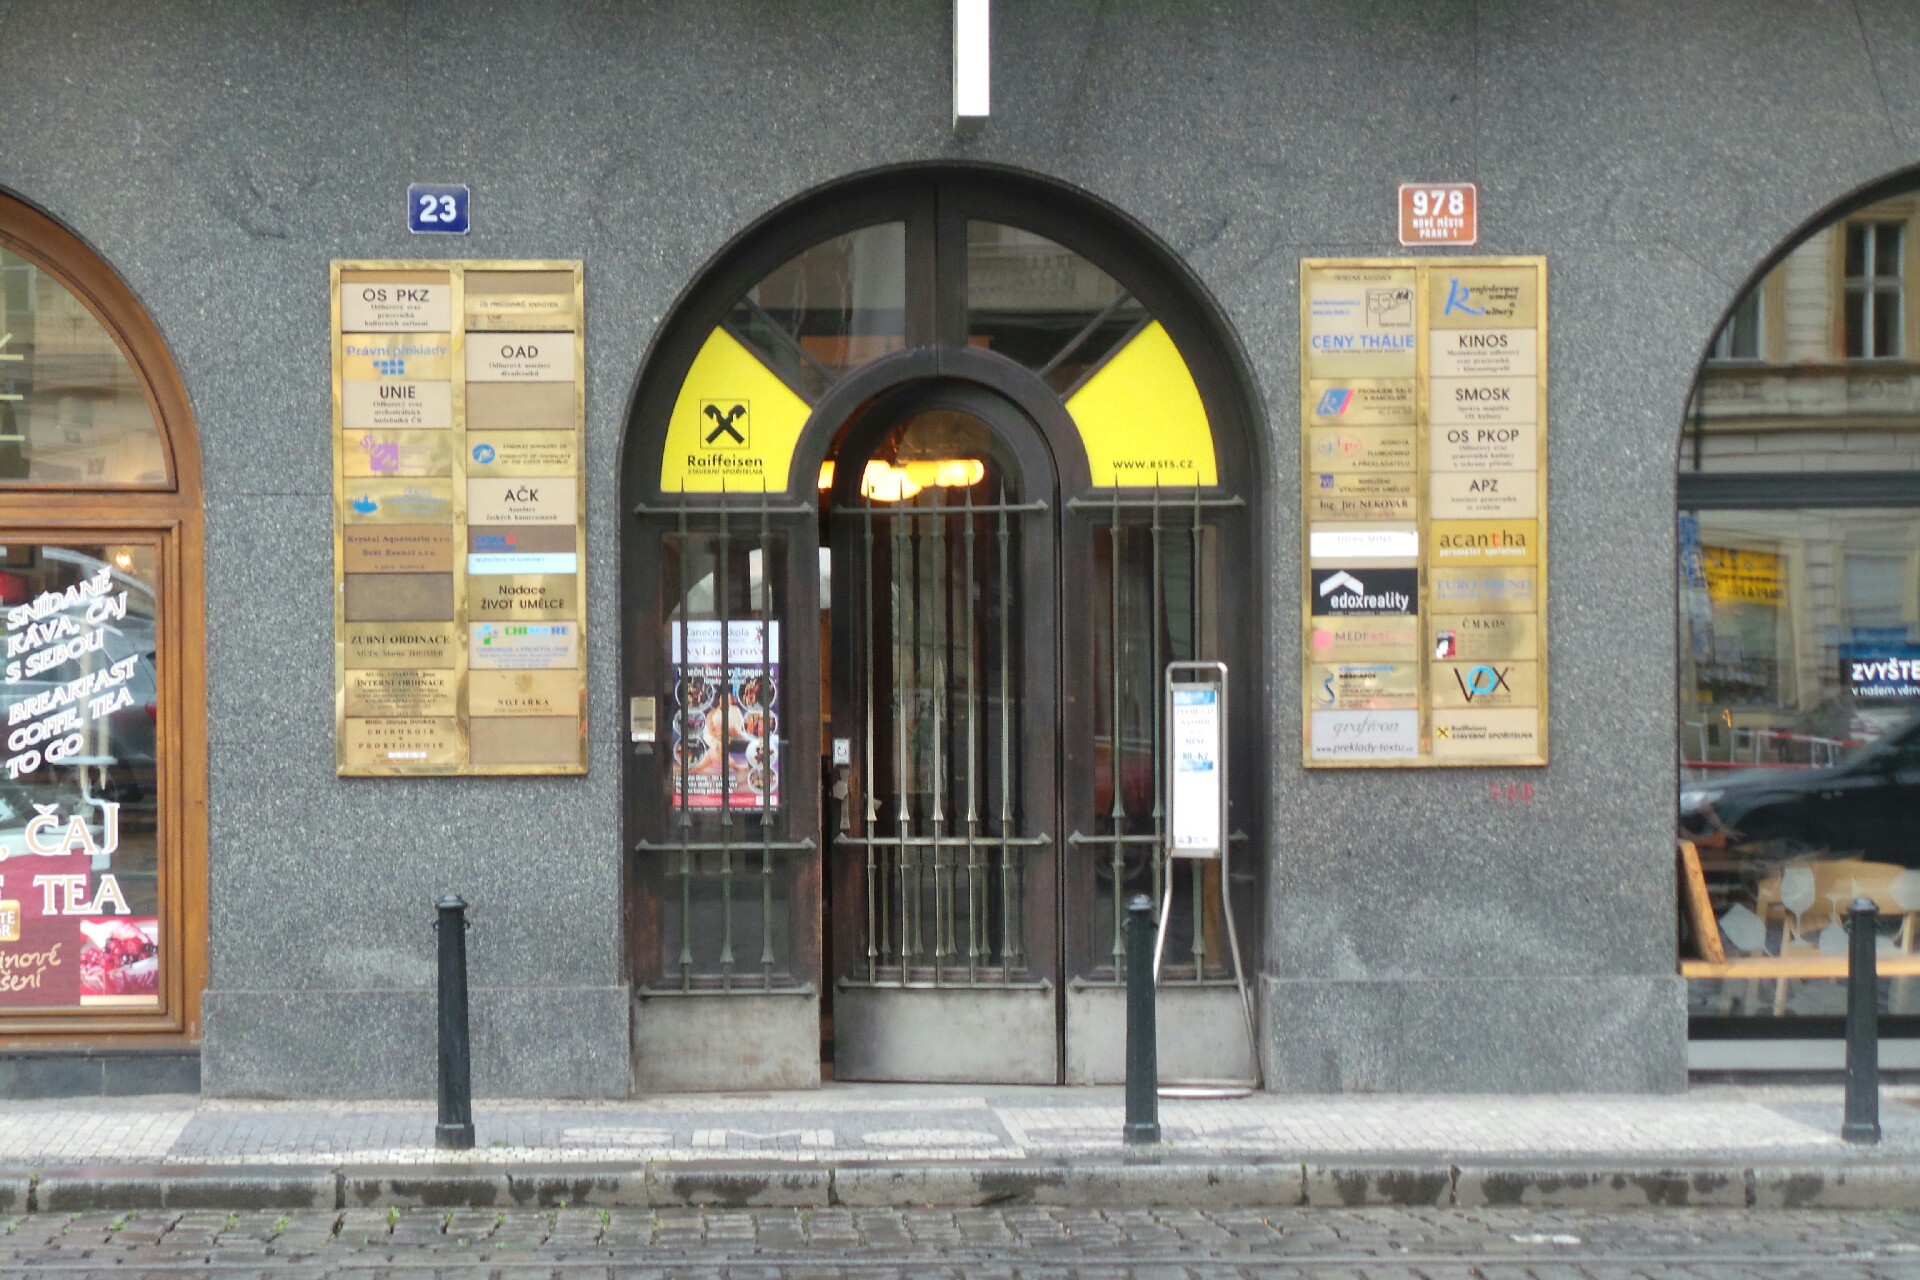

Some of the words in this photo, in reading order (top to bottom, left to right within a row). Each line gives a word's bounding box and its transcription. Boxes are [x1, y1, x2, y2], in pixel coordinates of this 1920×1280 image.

[419, 195, 457, 222] 23
[1413, 190, 1464, 216] 978
[1412, 217, 1434, 229] NOVÉ
[1437, 216, 1464, 229] MĚSTO
[1420, 228, 1448, 239] PRAHA
[1453, 228, 1457, 239] 1
[362, 288, 387, 302] OS
[396, 289, 430, 302] PKZ
[1312, 335, 1354, 349] CENY
[1360, 332, 1414, 348] THÁLIE
[1459, 334, 1508, 348] KINOS
[347, 345, 389, 356] Právní
[501, 345, 539, 359] OAD
[379, 386, 416, 399] UNIE
[1455, 387, 1511, 401] SMOSK
[1447, 429, 1469, 443] OS
[1477, 429, 1520, 442] PKOP
[687, 454, 763, 466] Raiffeisen
[1112, 460, 1194, 469] WWW.RSTS.CZ
[1469, 479, 1499, 492] APZ
[504, 485, 539, 502] AČK
[1440, 529, 1526, 548] acantha
[499, 585, 546, 595] Nadace
[6, 565, 113, 630] SNÍDANĚ
[481, 598, 513, 610] ŽIVOT
[1330, 591, 1409, 610] edoxreality
[350, 634, 386, 645] ZUBNÍ
[389, 634, 451, 645] ORDINACE
[5, 660, 21, 685] S
[25, 628, 104, 677] SEBOU
[1852, 656, 1920, 681] ZVYŠTE
[8, 654, 139, 726] BREAKFAST
[1453, 666, 1510, 702] VOX
[1851, 687, 1859, 696] v
[1860, 684, 1896, 696] našem
[88, 686, 135, 720] TEA
[5, 749, 41, 779] TO
[44, 733, 84, 764] GO
[25, 803, 120, 856] ČAJ
[33, 874, 131, 915] TEA
